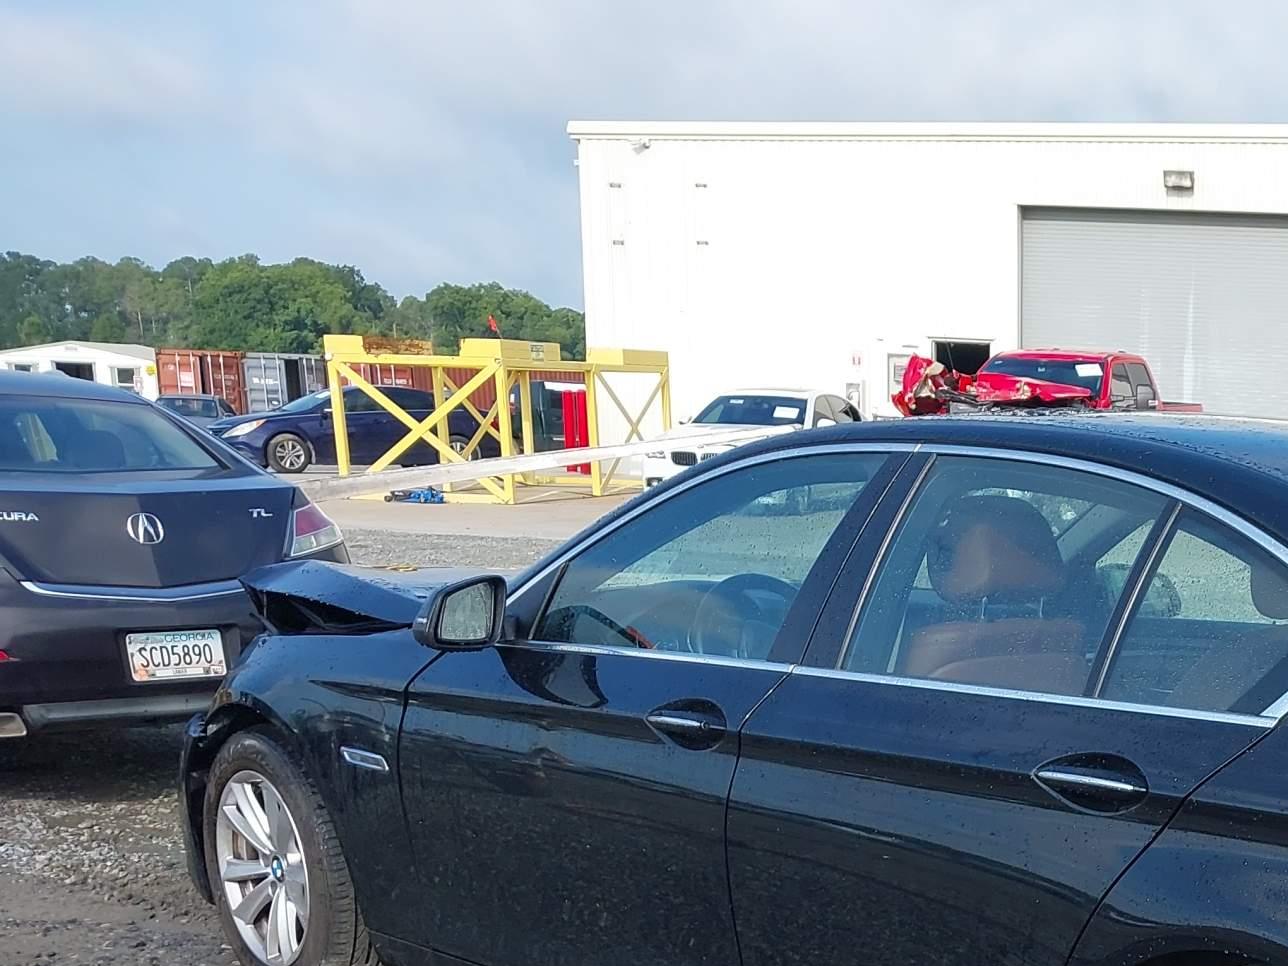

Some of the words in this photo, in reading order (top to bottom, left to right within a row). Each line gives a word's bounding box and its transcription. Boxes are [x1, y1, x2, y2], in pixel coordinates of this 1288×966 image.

[248, 508, 273, 518] TL
[164, 632, 215, 643] GEORGIA
[138, 643, 213, 668] SCD5890
